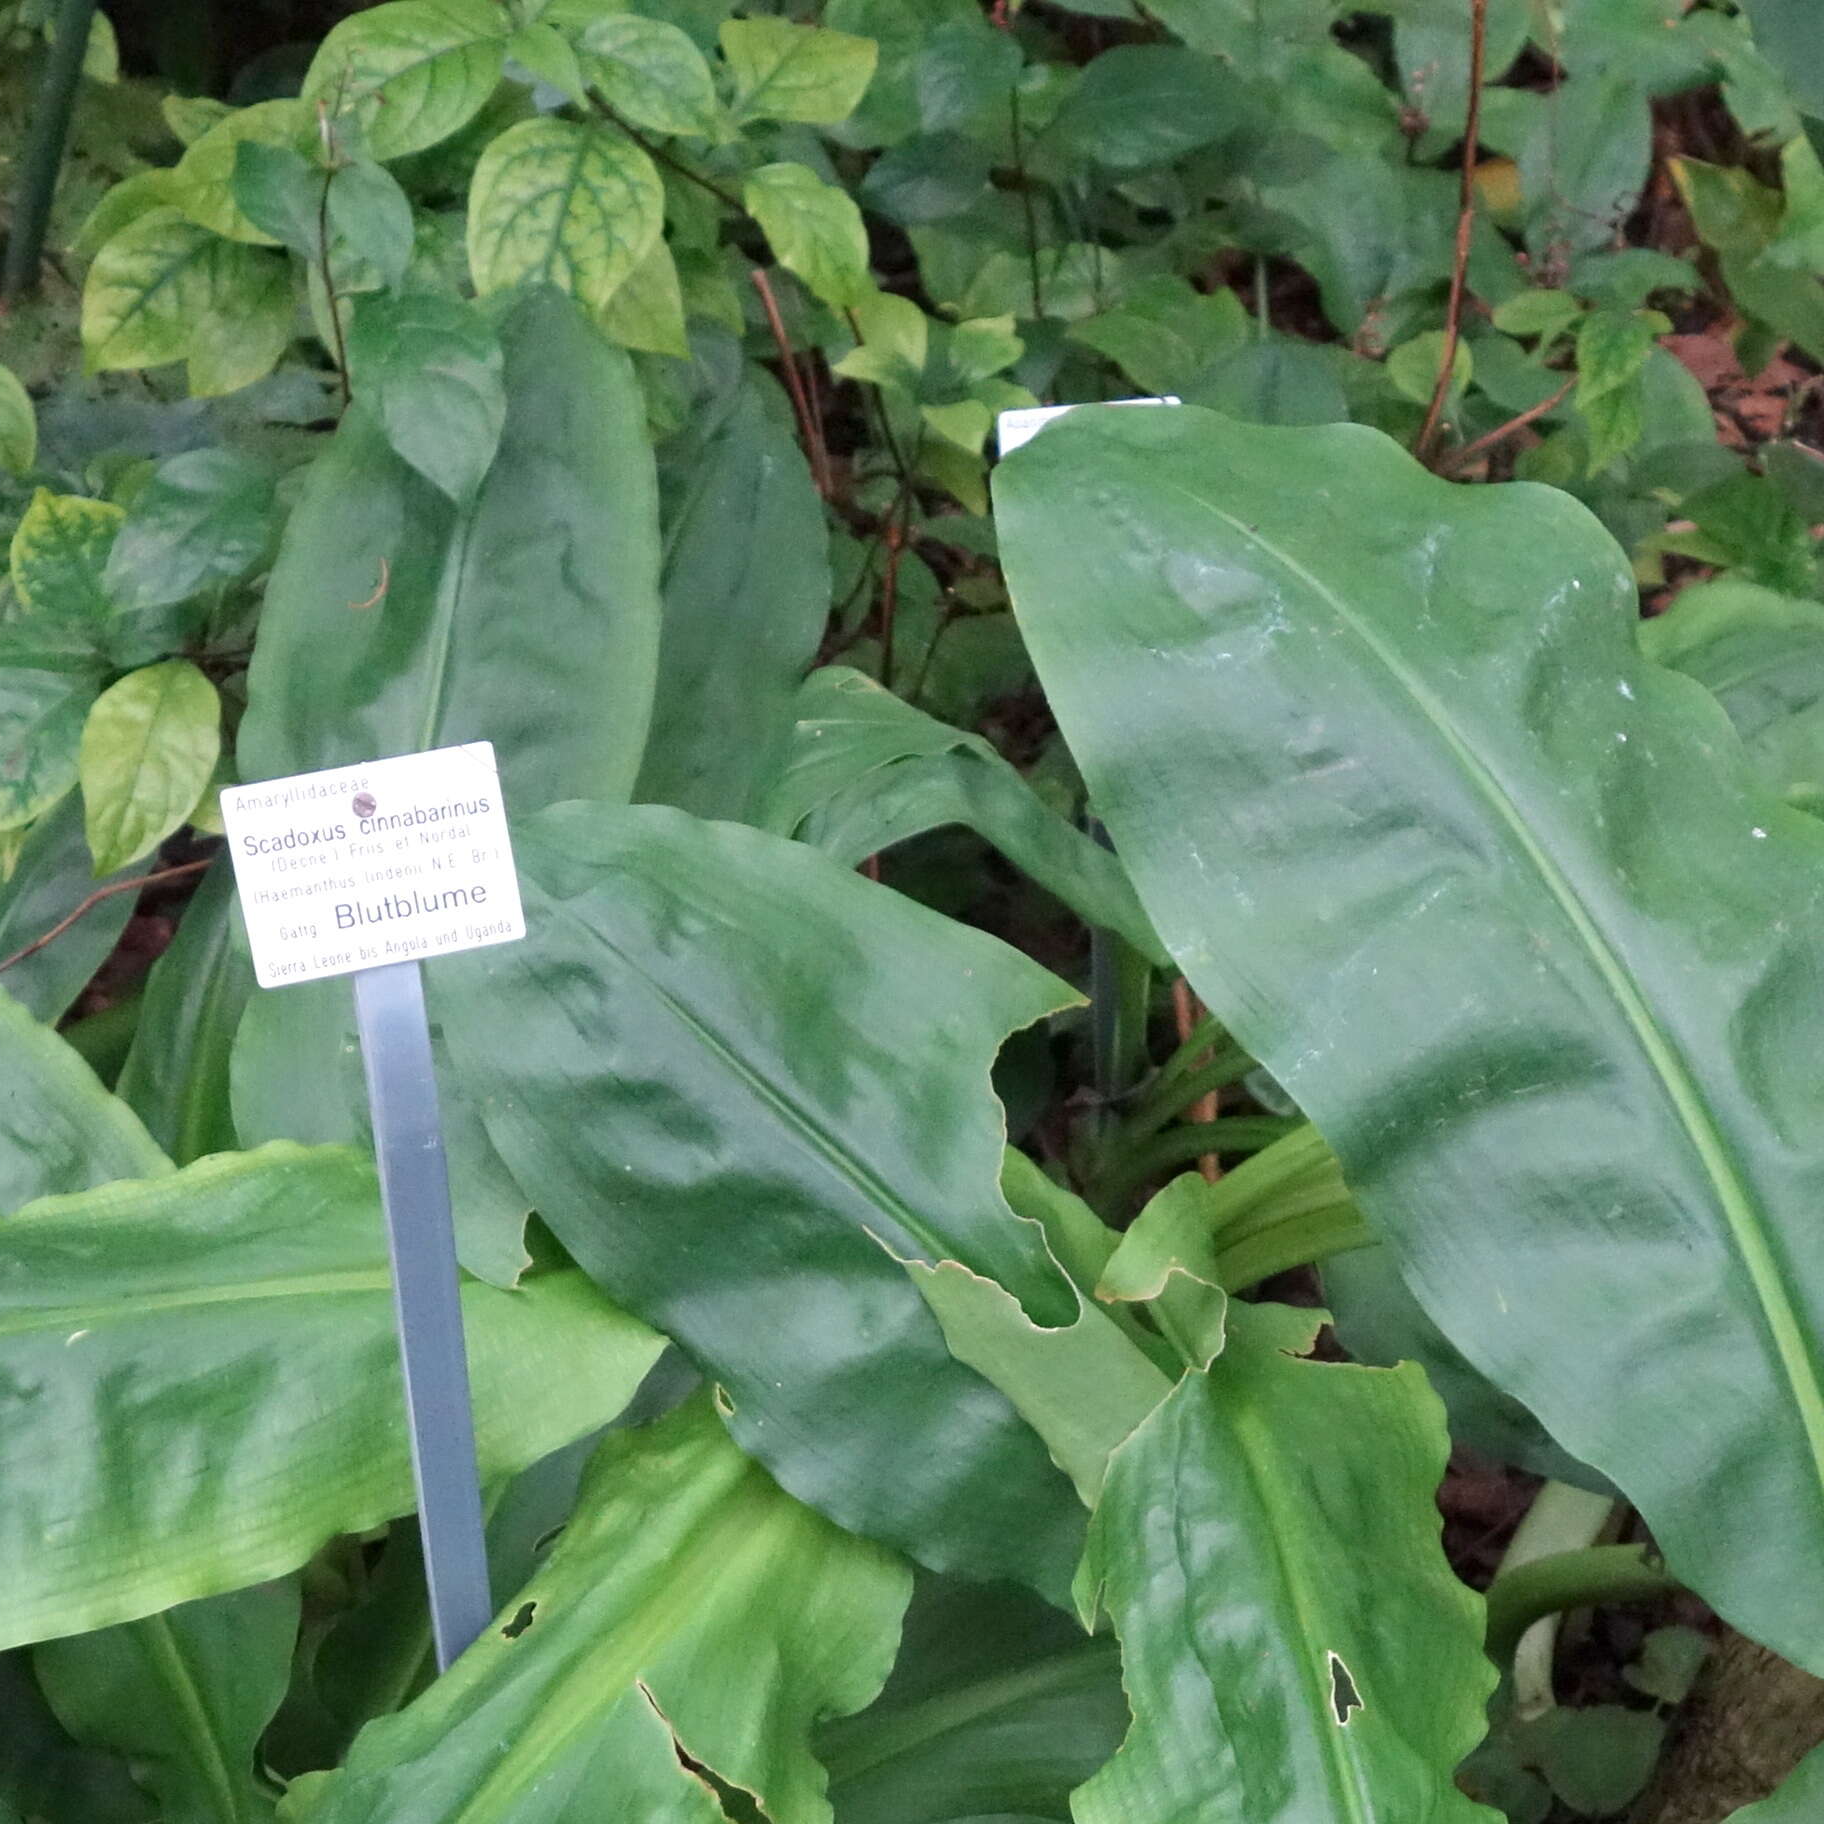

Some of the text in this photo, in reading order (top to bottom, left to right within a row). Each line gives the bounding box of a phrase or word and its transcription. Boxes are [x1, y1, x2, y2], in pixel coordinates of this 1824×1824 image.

[236, 778, 369, 812] Amaryllidaceae
[243, 797, 490, 856] Scadoxus cinnabarinus
[271, 848, 339, 872] (Decne)
[395, 836, 409, 850] et
[335, 885, 487, 930] Blutblume
[268, 920, 512, 978] Sierra Leone bis Angola und Uganda
